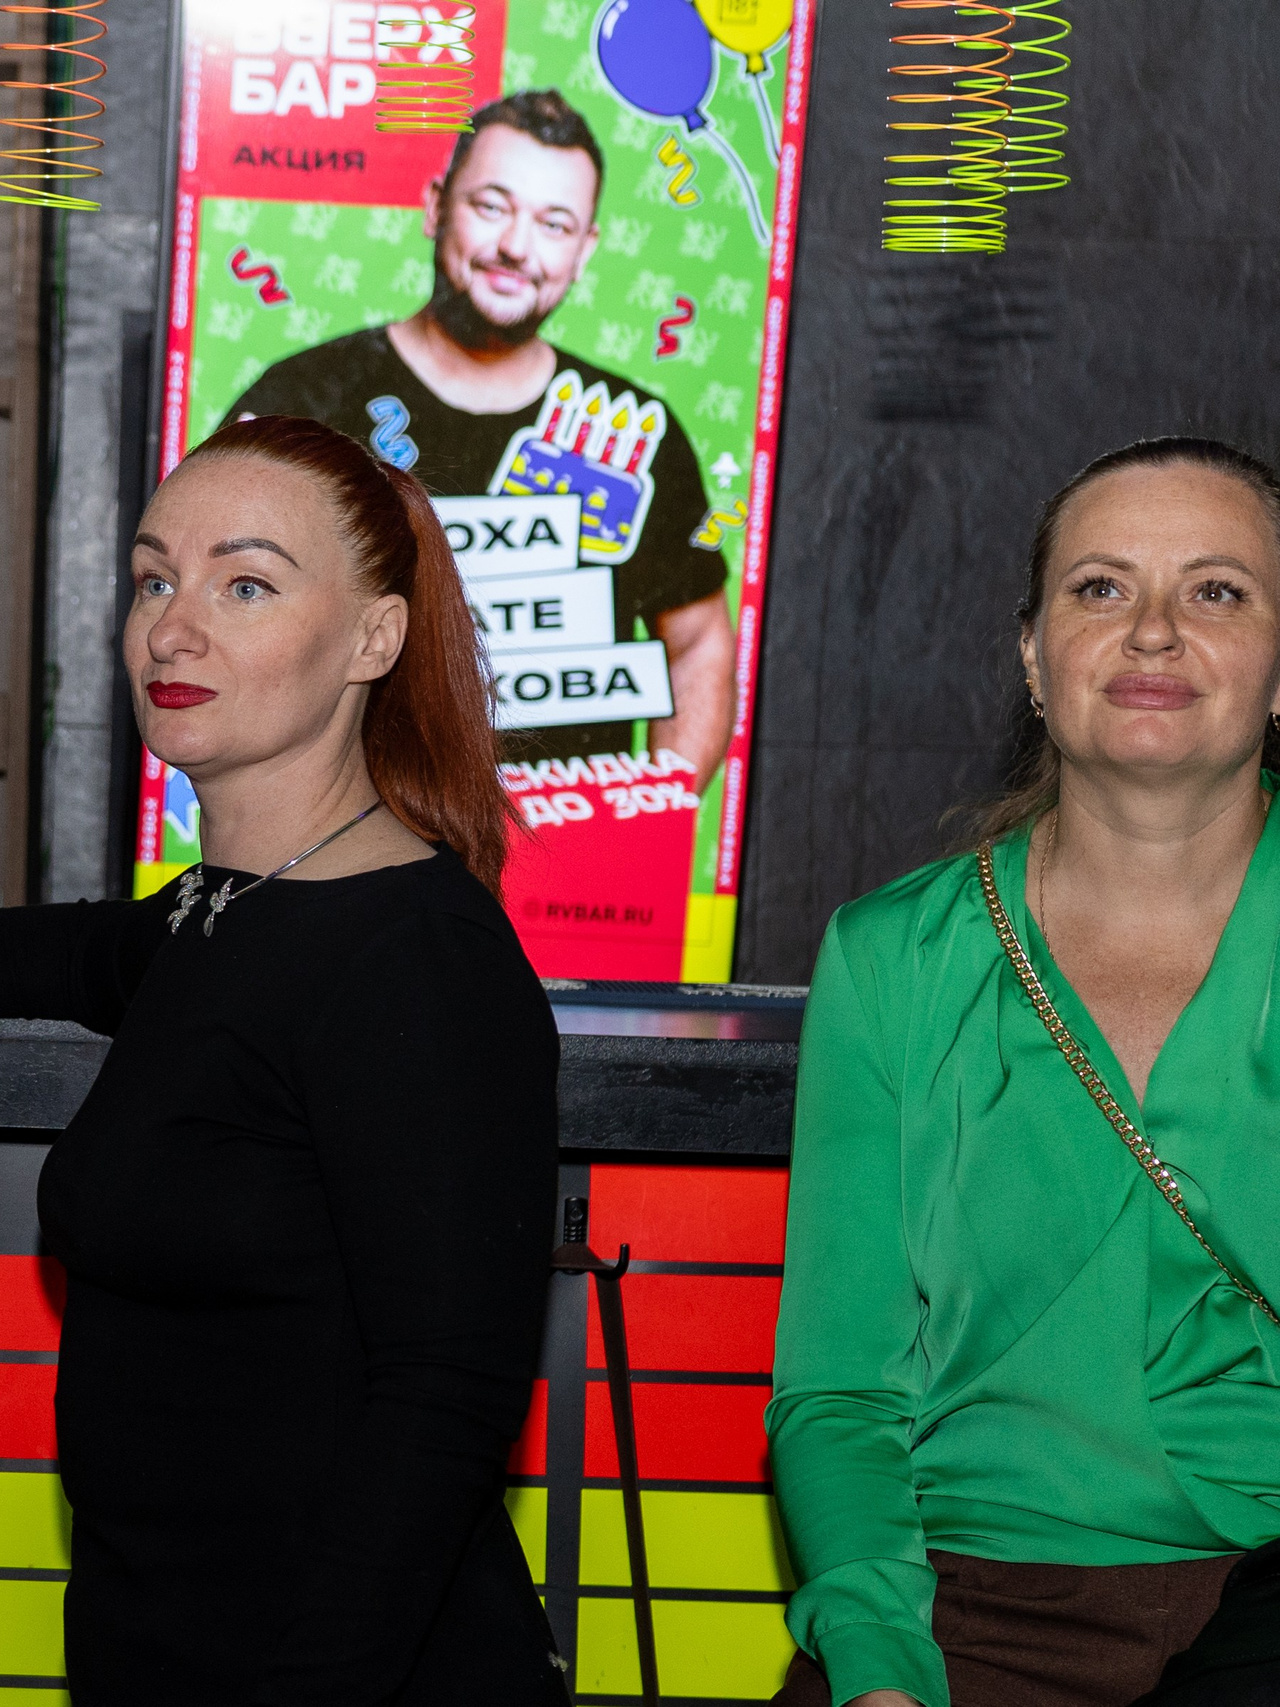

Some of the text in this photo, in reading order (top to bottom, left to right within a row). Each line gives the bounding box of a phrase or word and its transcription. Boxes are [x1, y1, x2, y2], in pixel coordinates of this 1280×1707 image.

[230, 58, 376, 119] БАР
[233, 144, 366, 173] АКЦИЯ
[496, 748, 698, 792] СКИДКА
[520, 780, 700, 829] ДО 30%
